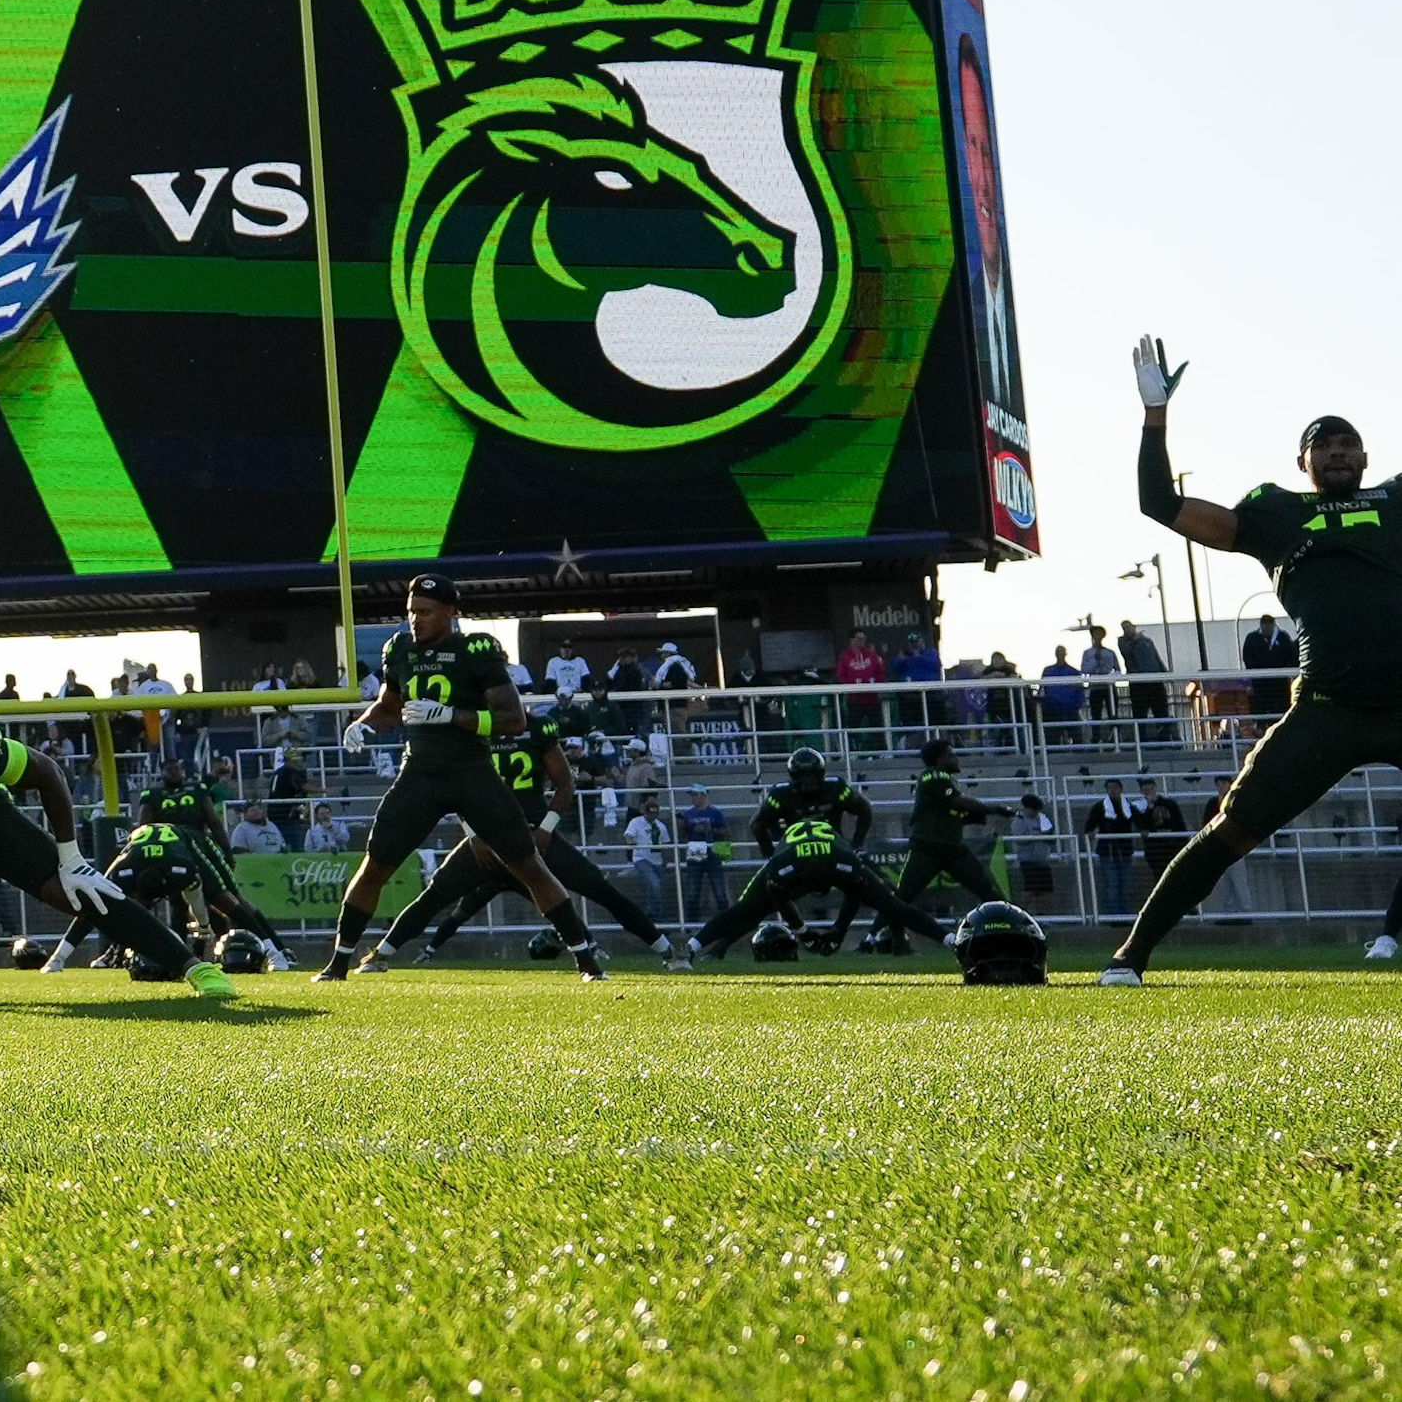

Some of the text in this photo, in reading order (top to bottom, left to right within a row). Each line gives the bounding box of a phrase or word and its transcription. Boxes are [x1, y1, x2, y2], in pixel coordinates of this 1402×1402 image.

[130, 162, 309, 242] VS
[1316, 500, 1372, 512] KINGS
[853, 604, 919, 627] Modelo
[796, 841, 831, 858] ALLEN
